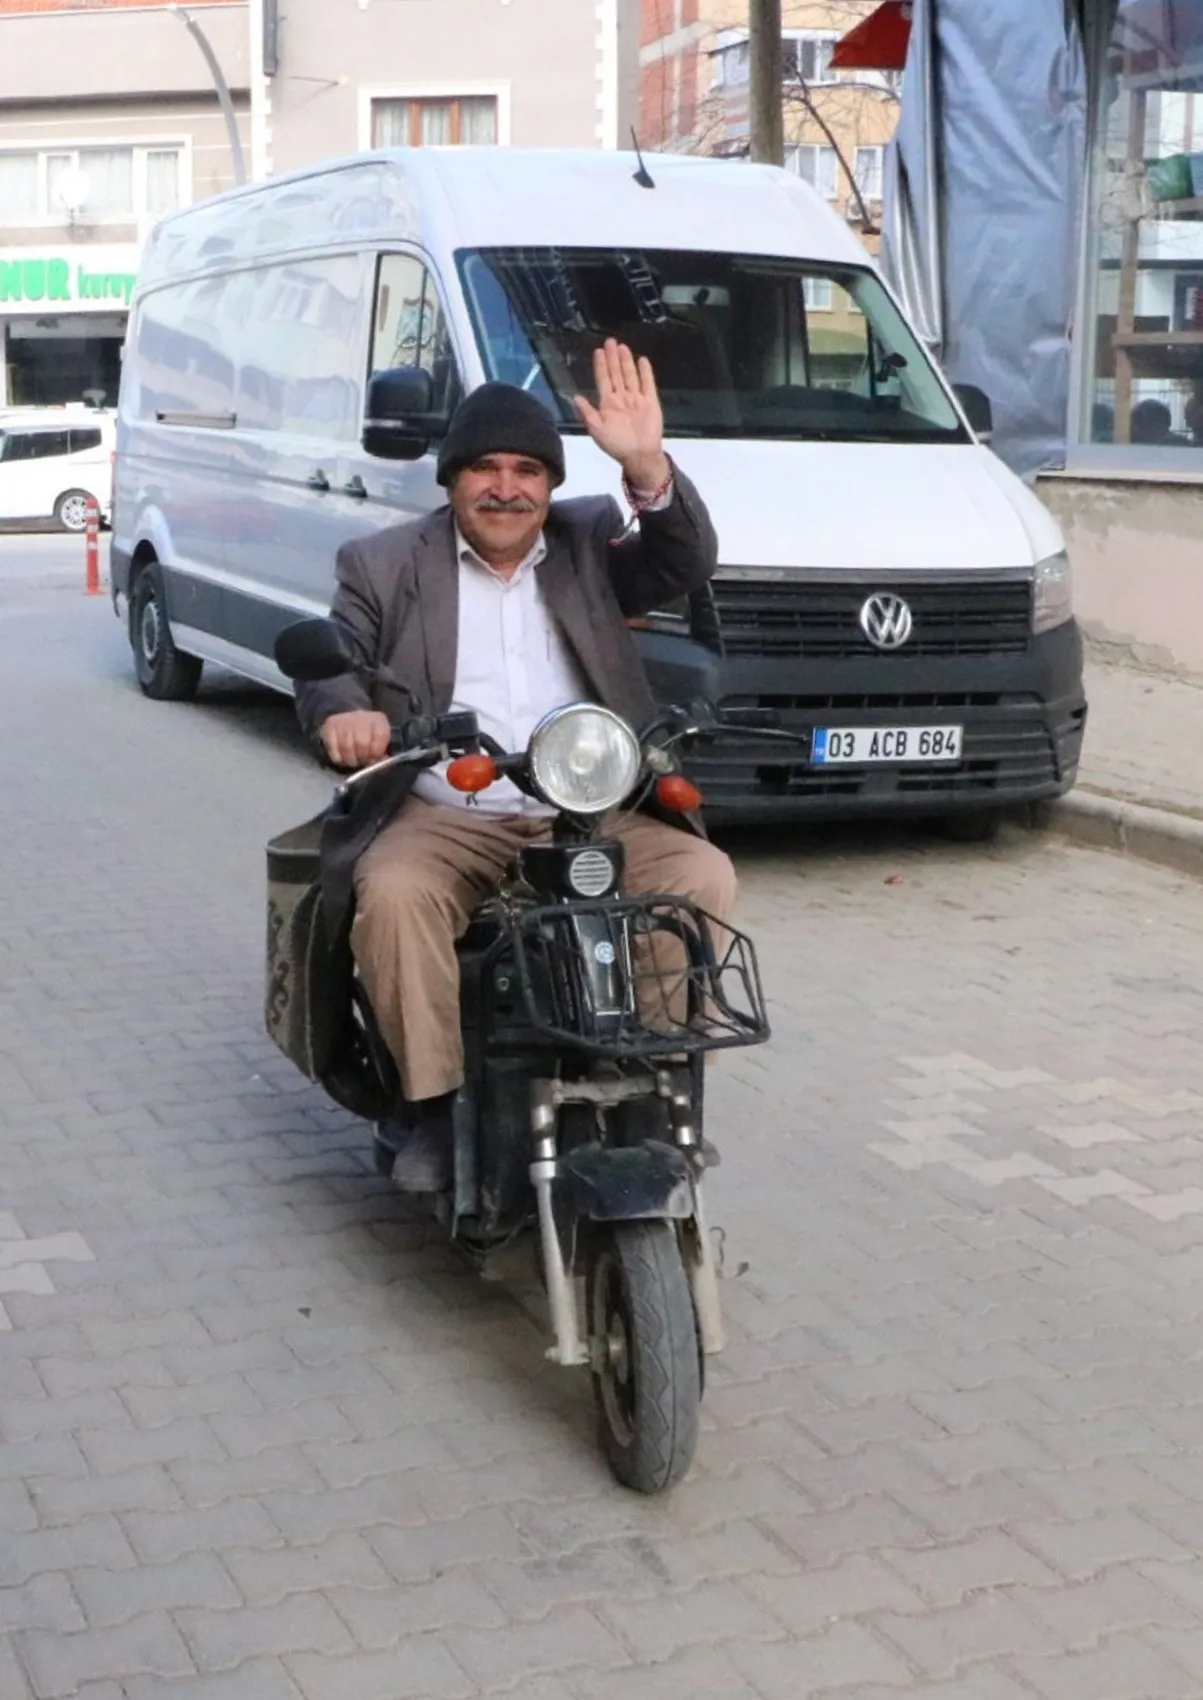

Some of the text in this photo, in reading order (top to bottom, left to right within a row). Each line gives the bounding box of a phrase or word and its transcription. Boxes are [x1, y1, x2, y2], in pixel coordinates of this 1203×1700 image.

[828, 732, 856, 758] 03
[868, 730, 908, 757] ACB
[918, 730, 956, 755] 684
